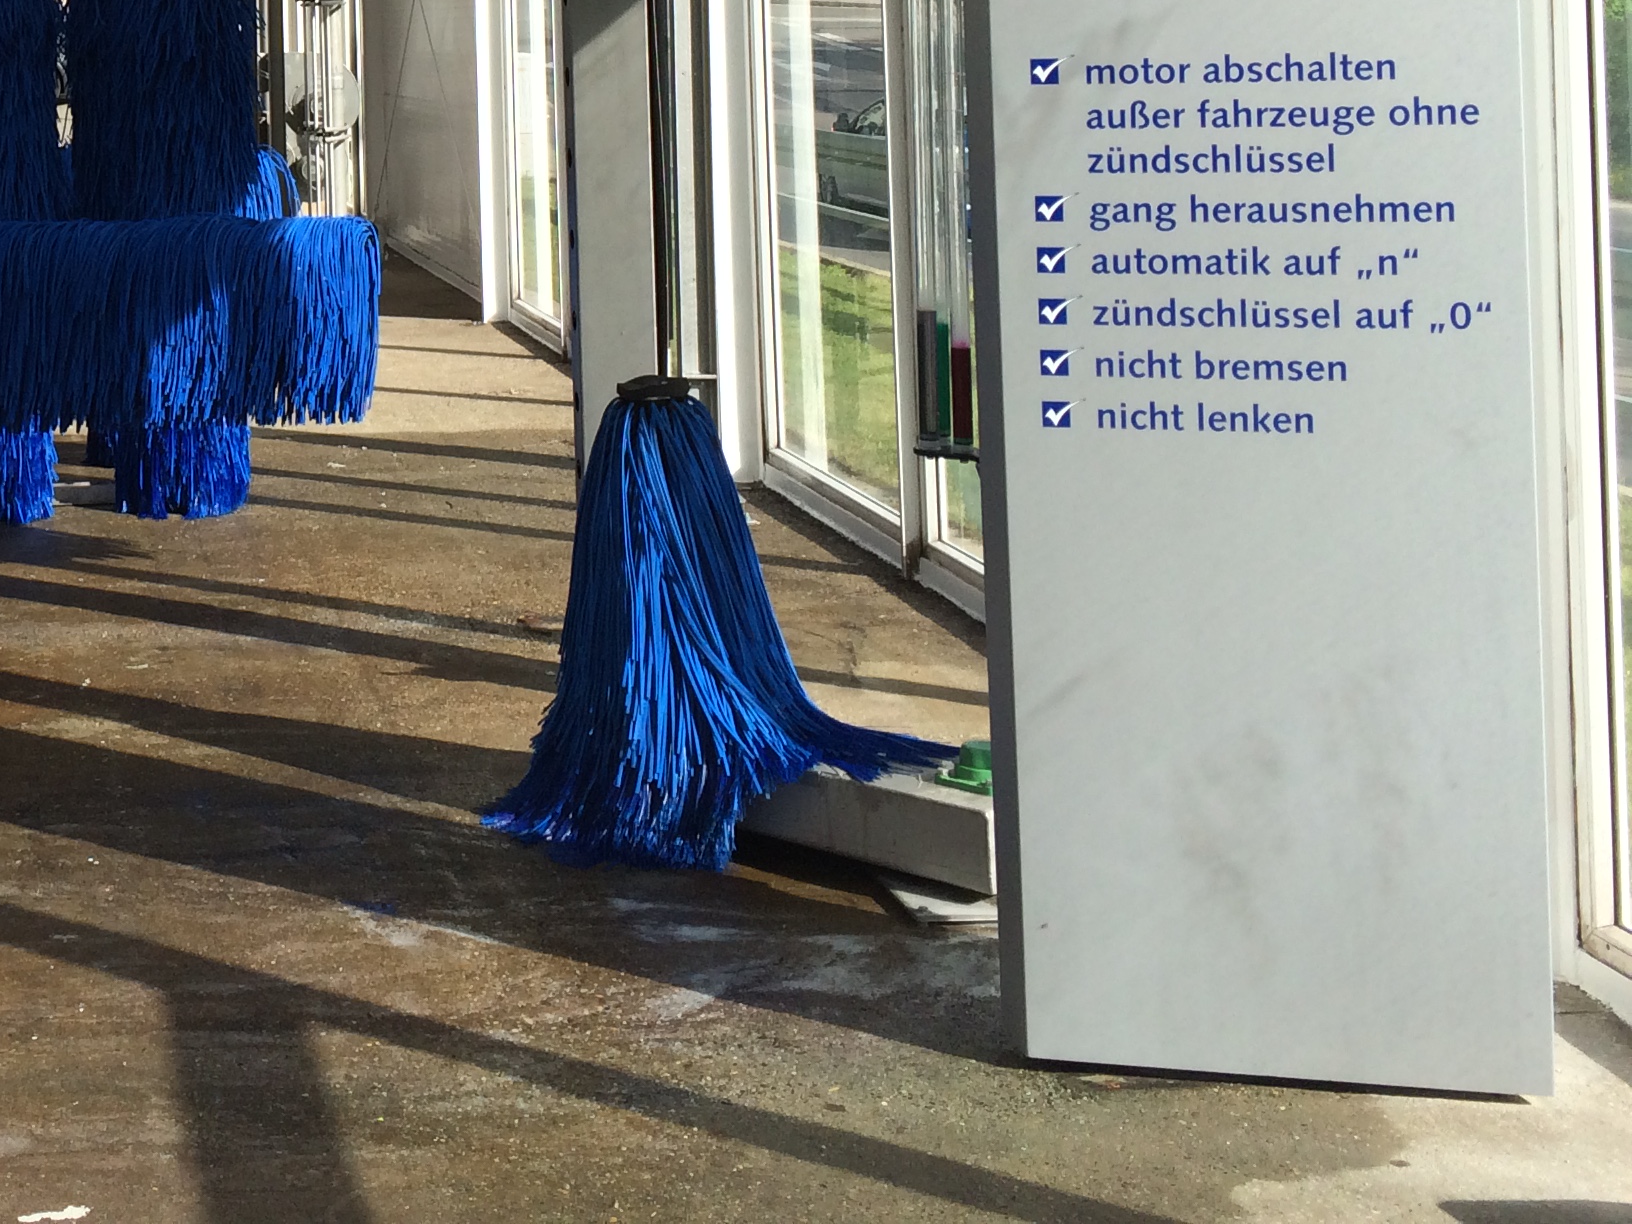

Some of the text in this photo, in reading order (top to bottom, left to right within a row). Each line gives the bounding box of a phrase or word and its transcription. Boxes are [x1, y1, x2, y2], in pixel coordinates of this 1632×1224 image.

[1085, 52, 1396, 84] motor abschalten
[1086, 96, 1479, 135] außer fahrzeuge ohne
[1087, 143, 1336, 174] zündschlüssel
[1089, 194, 1456, 232] gang herausnehmen
[1091, 247, 1269, 276] automatik
[1283, 246, 1342, 276] auf
[1092, 298, 1341, 330] zündschlüssel
[1355, 300, 1414, 330] auf
[1095, 351, 1347, 382] nicht bremsen
[1097, 402, 1314, 434] nicht lenken
